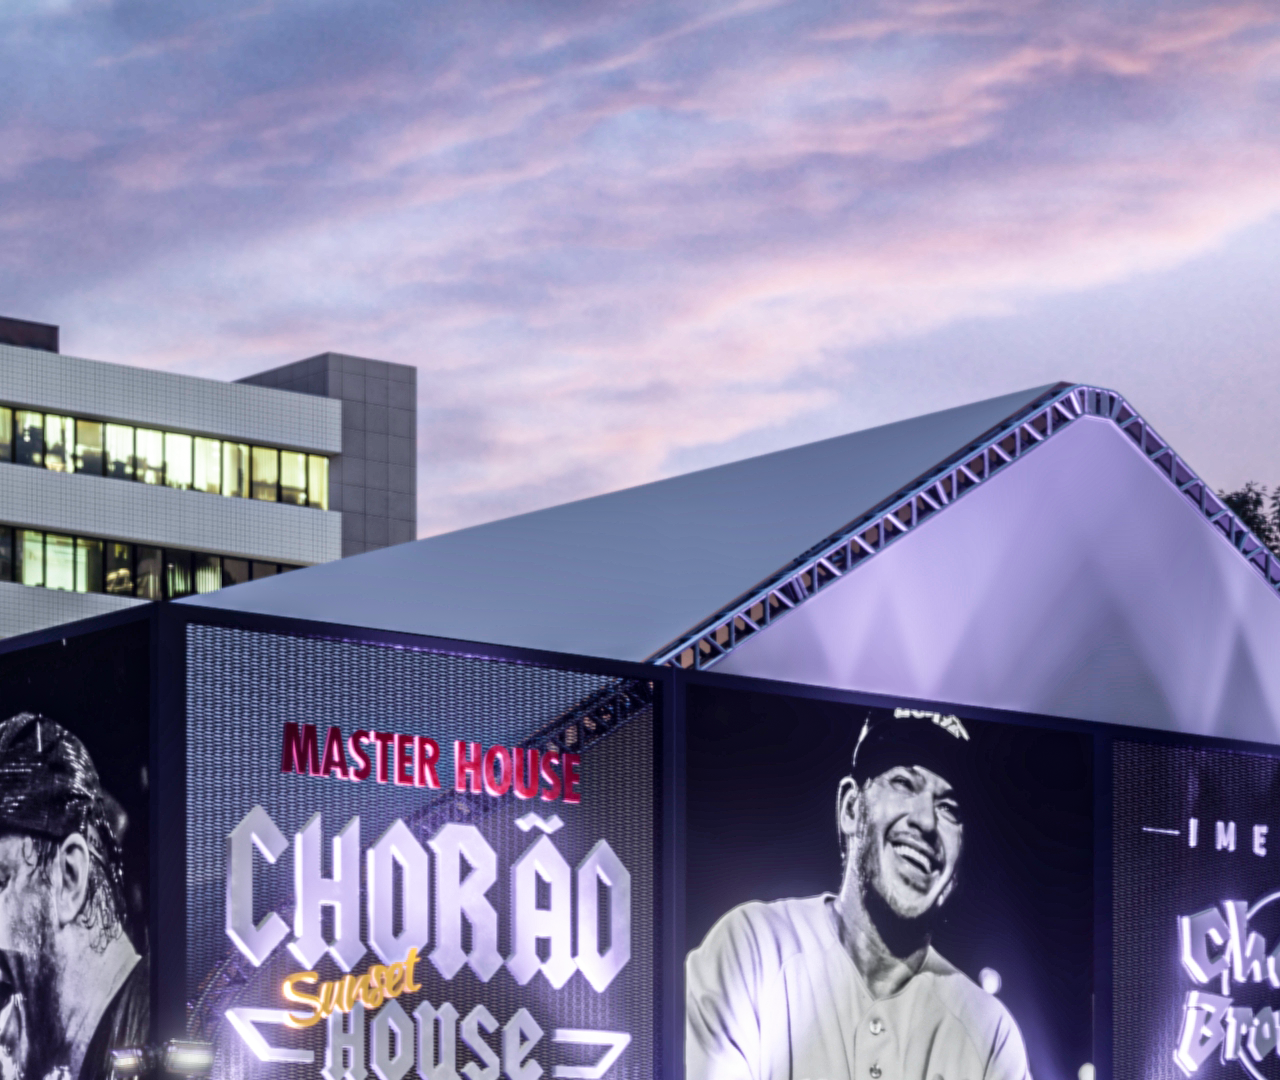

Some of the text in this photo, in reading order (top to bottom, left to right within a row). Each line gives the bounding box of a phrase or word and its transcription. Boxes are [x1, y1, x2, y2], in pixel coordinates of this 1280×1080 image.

[281, 721, 581, 803] MASTER HOUSE
[226, 804, 632, 994] CHORÃO
[282, 945, 422, 1030] Sunset
